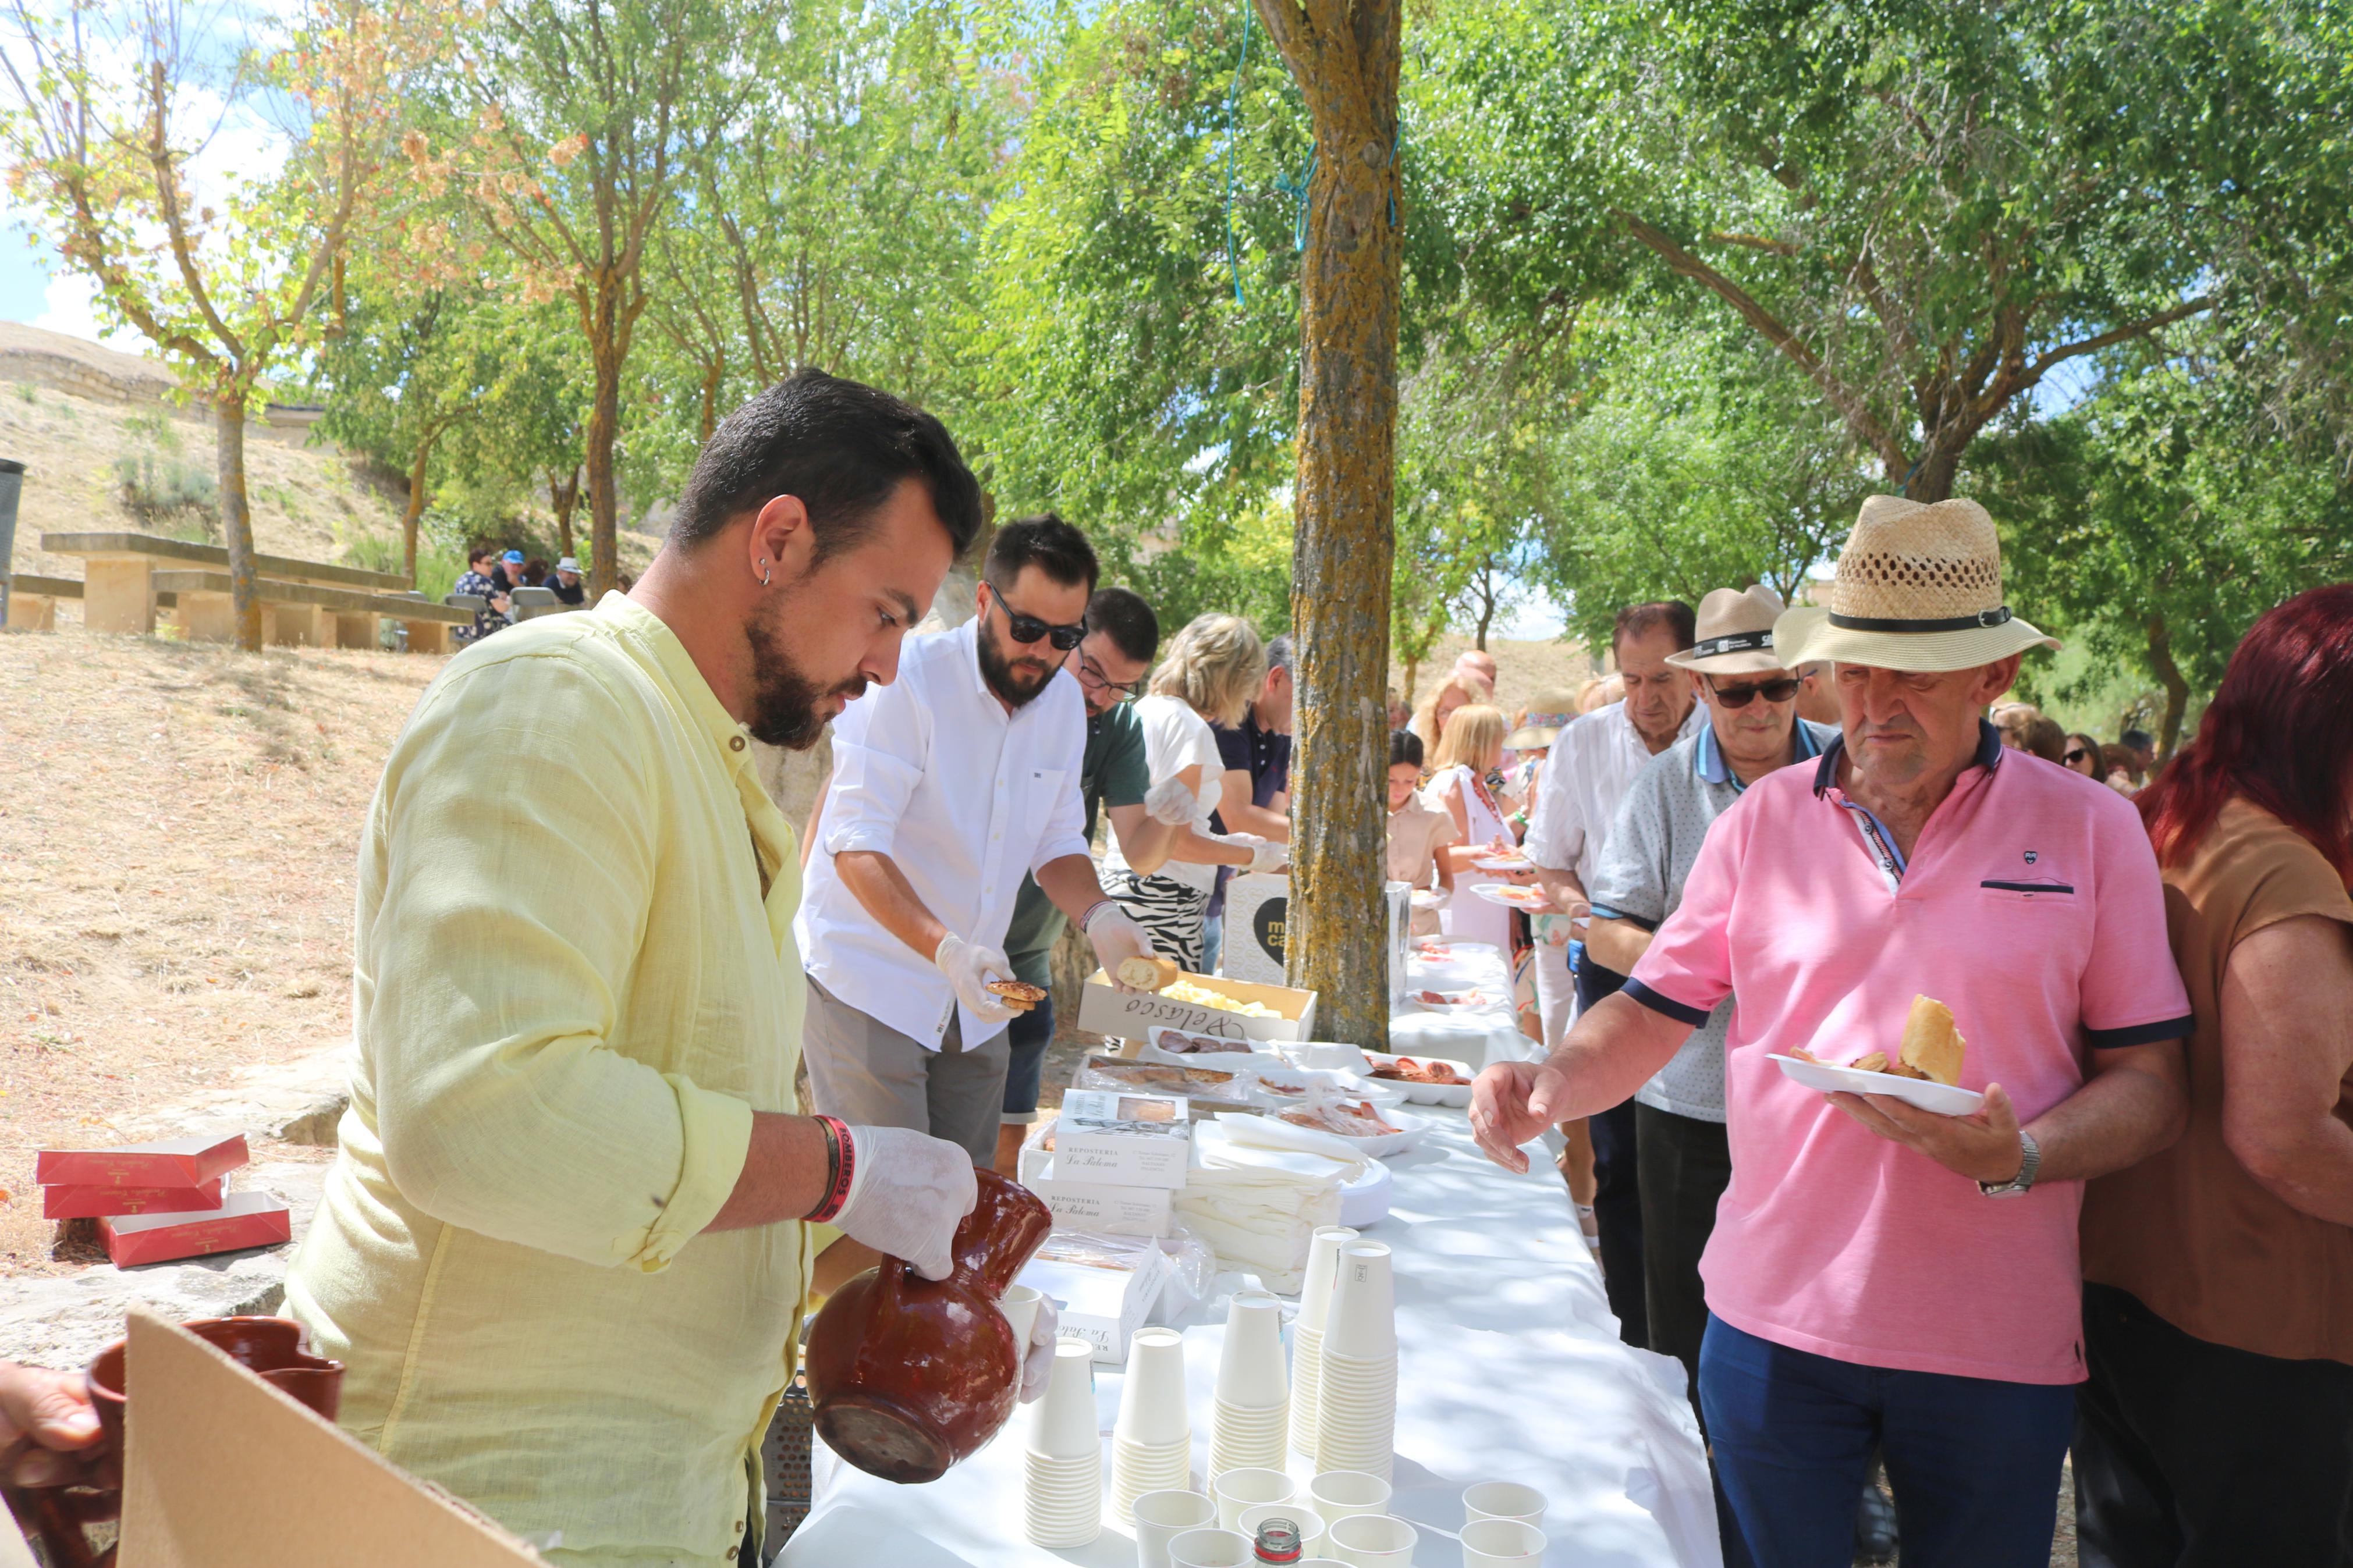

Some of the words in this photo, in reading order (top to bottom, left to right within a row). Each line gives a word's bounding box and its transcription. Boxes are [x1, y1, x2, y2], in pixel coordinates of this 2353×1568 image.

[1268, 921, 1284, 933] m
[1267, 934, 1285, 947] ca
[1125, 1000, 1244, 1040] Velasco
[1069, 1147, 1118, 1155] REPOSTERIA
[838, 1128, 852, 1196] BOMBEROS
[1066, 1154, 1079, 1165] La
[1083, 1155, 1118, 1168] Paloma
[1051, 1196, 1099, 1205] REPOSTERIA
[1049, 1202, 1062, 1213] La
[1066, 1205, 1099, 1217] Paloma
[1059, 1325, 1086, 1337] Palo
